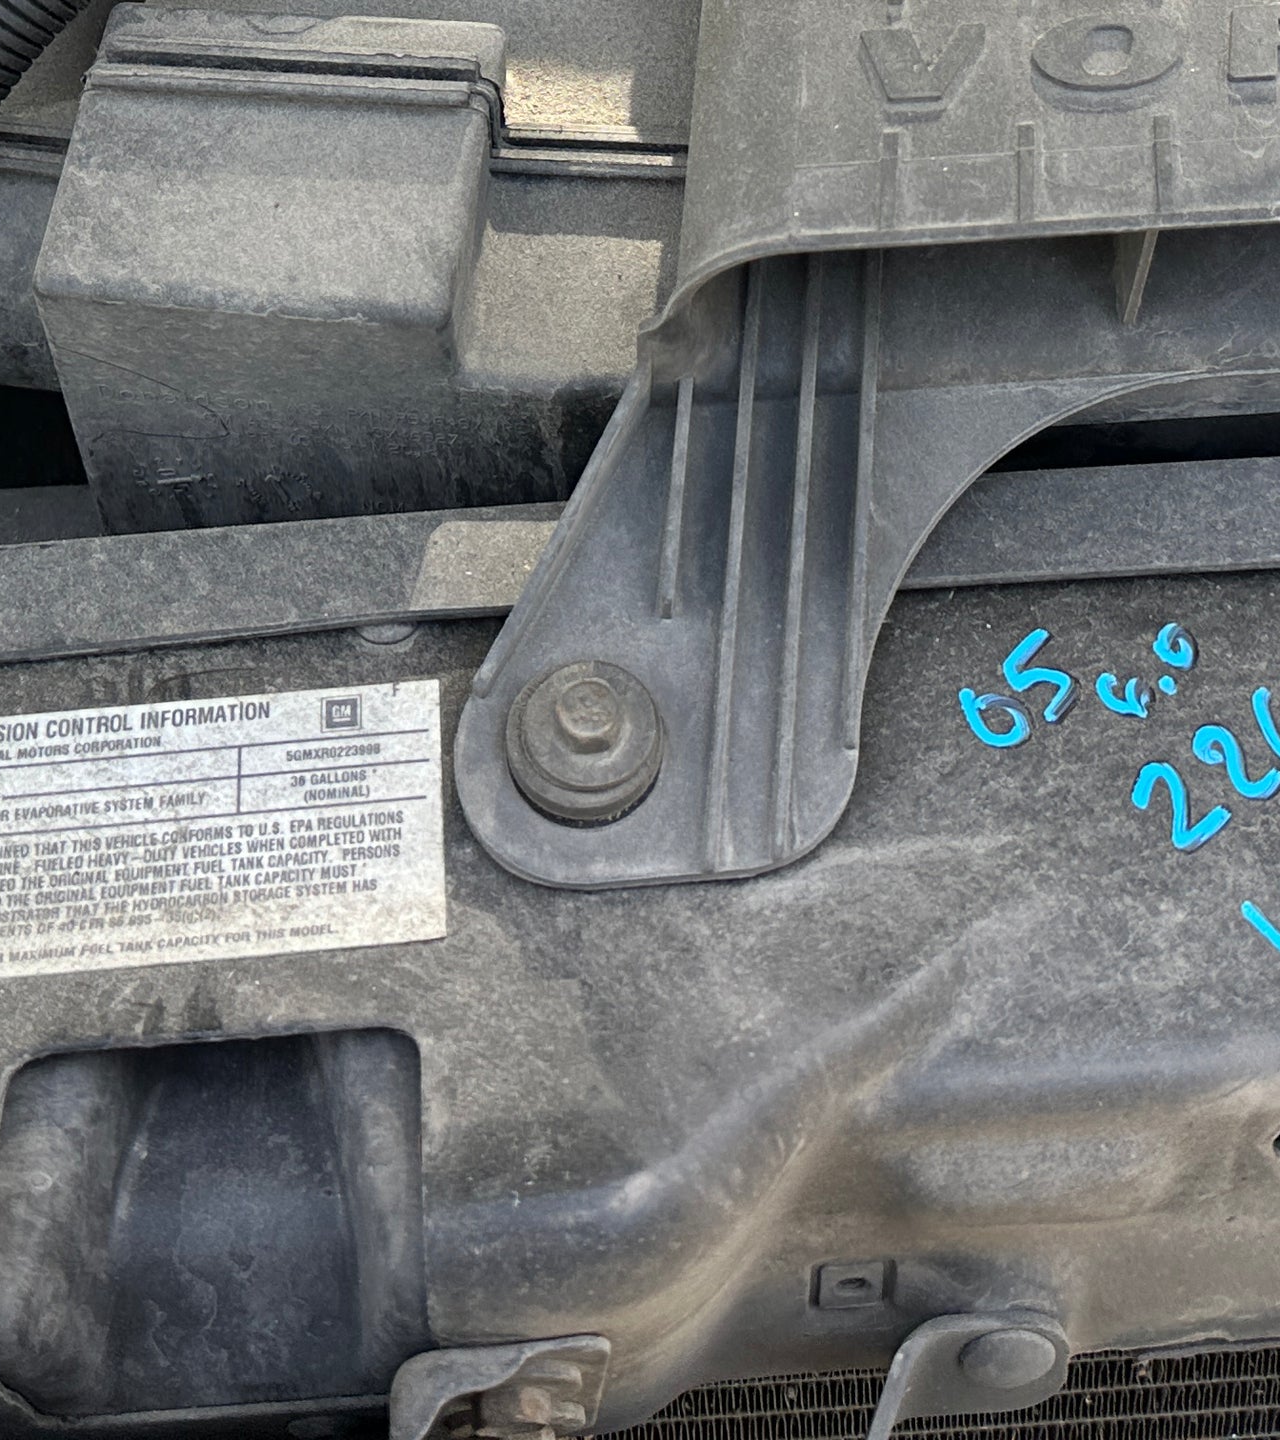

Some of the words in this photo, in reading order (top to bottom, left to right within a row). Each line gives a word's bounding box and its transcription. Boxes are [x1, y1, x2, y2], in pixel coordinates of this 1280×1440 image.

[45, 712, 133, 738] CONTROL
[140, 701, 270, 730] INFORMATION
[17, 743, 70, 759] MOTORS
[74, 735, 161, 754] CORPORATION
[303, 785, 370, 803] (NOMINAL)
[310, 769, 367, 785] GALLONS
[14, 801, 97, 820] EVAPORATIVE
[103, 797, 153, 813] SYSTEM
[158, 792, 206, 808] FAMILY
[34, 839, 67, 855] THAT
[71, 836, 101, 852] THIS
[105, 832, 156, 849] VEHICLE
[238, 823, 253, 838] TO
[290, 818, 312, 833] EPA
[317, 810, 403, 831] REGULATIONS
[182, 841, 242, 858] VEHICLES
[246, 837, 284, 853] WHEN
[289, 830, 364, 849] COMPLETED
[369, 827, 402, 842] WITH
[20, 874, 45, 889] THE
[49, 869, 109, 887] ORIGINAL
[113, 862, 188, 881] EQUIPMENT
[193, 859, 225, 875] FUEL
[230, 856, 263, 871] TANK
[342, 844, 400, 862] PERSONS
[6, 892, 31, 907] THE
[34, 886, 94, 904] ORIGINAL
[100, 880, 174, 899] EQUIPMENT
[179, 876, 212, 892] FUEL
[218, 873, 250, 888] TANK
[254, 868, 314, 885] CAPACITY
[64, 902, 99, 917] THAT
[103, 900, 128, 914] THE
[132, 891, 227, 911] HYDROCARBON
[233, 886, 290, 903] STORAGE
[295, 881, 347, 898] SYSTEM
[351, 879, 377, 893] HAS
